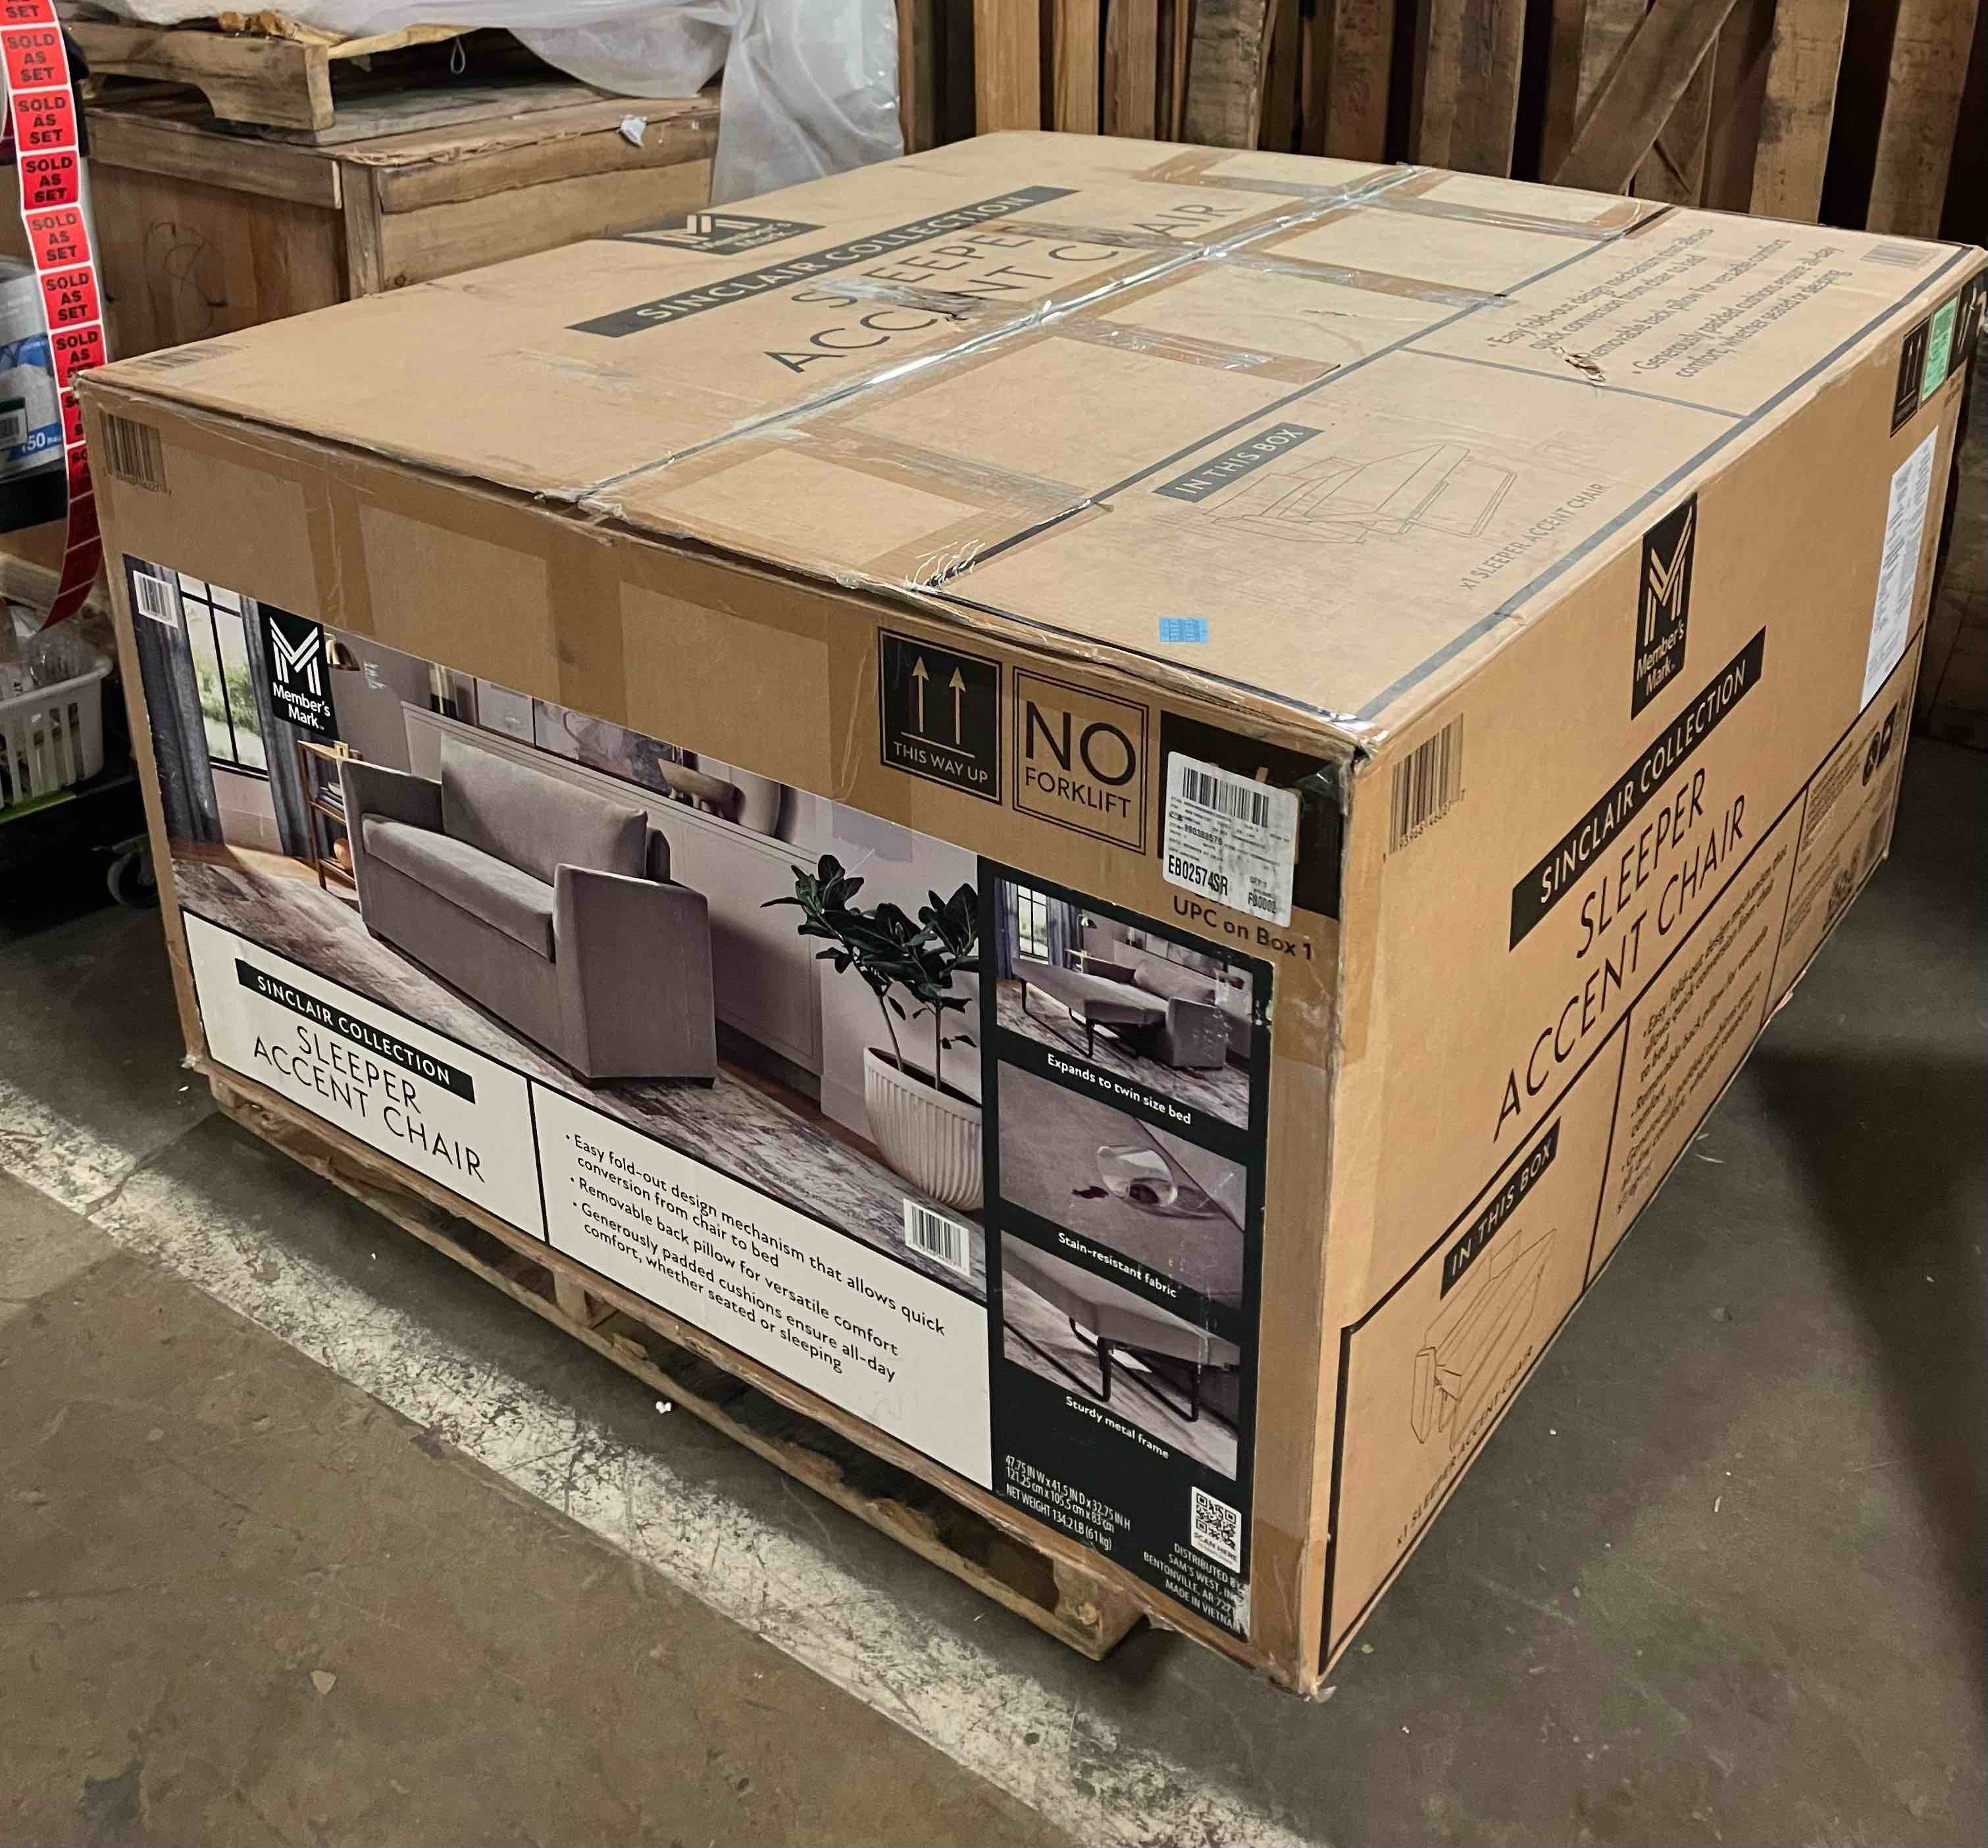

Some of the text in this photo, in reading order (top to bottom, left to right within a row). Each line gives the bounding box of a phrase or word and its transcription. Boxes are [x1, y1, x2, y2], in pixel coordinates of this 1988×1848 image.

[6, 5, 39, 18] SET
[7, 34, 55, 49] SOLD
[24, 51, 46, 65] AS
[20, 67, 53, 82] SET
[18, 97, 65, 112] SOLD
[34, 113, 56, 127] AS
[26, 156, 72, 173] SOLD
[30, 128, 63, 144] SET
[34, 187, 68, 203] SET
[39, 173, 61, 187] AS
[33, 212, 77, 230] SOLD
[49, 230, 70, 245] AS
[46, 245, 77, 261] SET
[46, 272, 89, 291] SOLD
[637, 262, 827, 320] SINCLAIR
[827, 195, 1034, 261] COLLECTION
[58, 304, 88, 321] SET
[61, 290, 82, 305] AS
[763, 205, 1244, 373] ACCNT CAIR
[56, 330, 98, 351] SOLD
[70, 348, 89, 363] AS
[1175, 428, 1304, 494] IN THIS BOX
[1470, 541, 1531, 579] SLEEPER
[1521, 507, 1575, 547] ACCENT
[1566, 484, 1612, 509] CHAIR
[1637, 620, 1684, 682] Member's
[272, 682, 330, 716] Member's
[893, 741, 988, 784] THIS WAY UP
[1025, 701, 1136, 786] NO
[1025, 766, 1132, 818] FORKLIFT
[1541, 660, 1746, 905] SINCLAIR COLLECTION
[1576, 768, 1705, 959] SLEEPER
[1174, 895, 1311, 960] UPC on Box 1
[1492, 795, 1745, 1143] ACCENT CHAIR
[257, 976, 450, 1086] SINCLAIR COLLECTION
[297, 1026, 421, 1114] SLEEPER
[1048, 1053, 1192, 1124] Expands to twin size bed
[254, 1036, 485, 1183] ACCENT CHAIR
[578, 1157, 779, 1268] conversion from chair to bed
[1452, 1137, 1552, 1276] IN THIS BOX
[574, 1134, 946, 1337] Easy fold-out design mechanism that allows quick
[579, 1177, 898, 1357] Removable back pillow for versatile comfort
[582, 1203, 895, 1383] Generously padded cushions ensure all-day
[1058, 1232, 1177, 1299] Stain-resistant fabric
[584, 1224, 842, 1374] comfort, whether seated or sleeping
[1065, 1395, 1169, 1460] Sturdy metal frame
[1006, 1455, 1131, 1532] 47.75 IN W x 41.5 IN D x 32.75 IN H
[1006, 1466, 1031, 1488] 121.25
[1032, 1483, 1044, 1495] cm
[1044, 1489, 1050, 1499] x
[1050, 1491, 1071, 1510] 105.5
[1072, 1505, 1084, 1517] cm
[1085, 1511, 1090, 1520] x
[1102, 1520, 1114, 1534] cm
[1006, 1483, 1112, 1551] NET WEIGHT 134.2 LB (61 kg)
[1169, 1554, 1194, 1577] SAM'S
[1174, 1542, 1228, 1584] DISTRIBUTED
[1165, 1579, 1189, 1601] MADE
[1191, 1597, 1200, 1609] IN
[1202, 1589, 1214, 1604] AR
